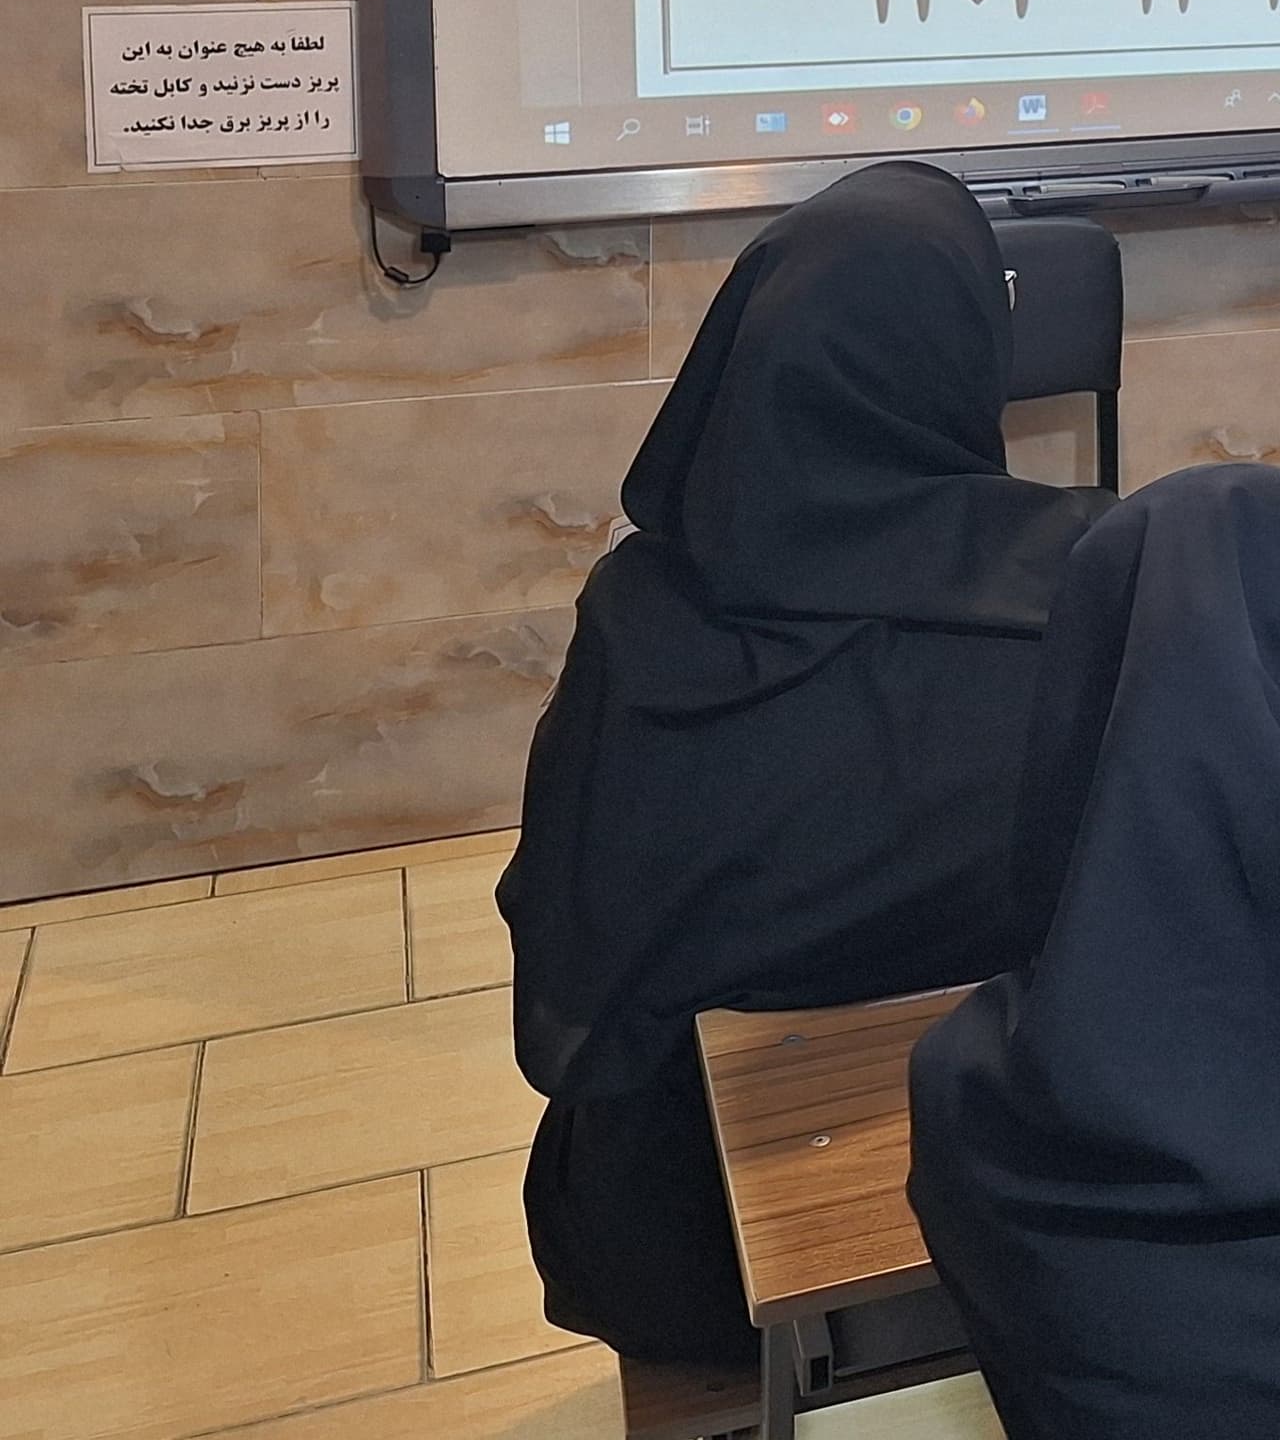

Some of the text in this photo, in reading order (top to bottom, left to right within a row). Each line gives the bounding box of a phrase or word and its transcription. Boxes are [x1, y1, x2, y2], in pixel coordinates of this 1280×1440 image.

[122, 41, 150, 61] این
[156, 45, 172, 60] به
[178, 40, 227, 59] عنوان
[234, 41, 265, 58] هیچ
[270, 41, 286, 56] به
[110, 75, 339, 98] پریز دست نزنید و کابل تخته
[123, 110, 330, 136] را از پریز برق جدا نکنید.
